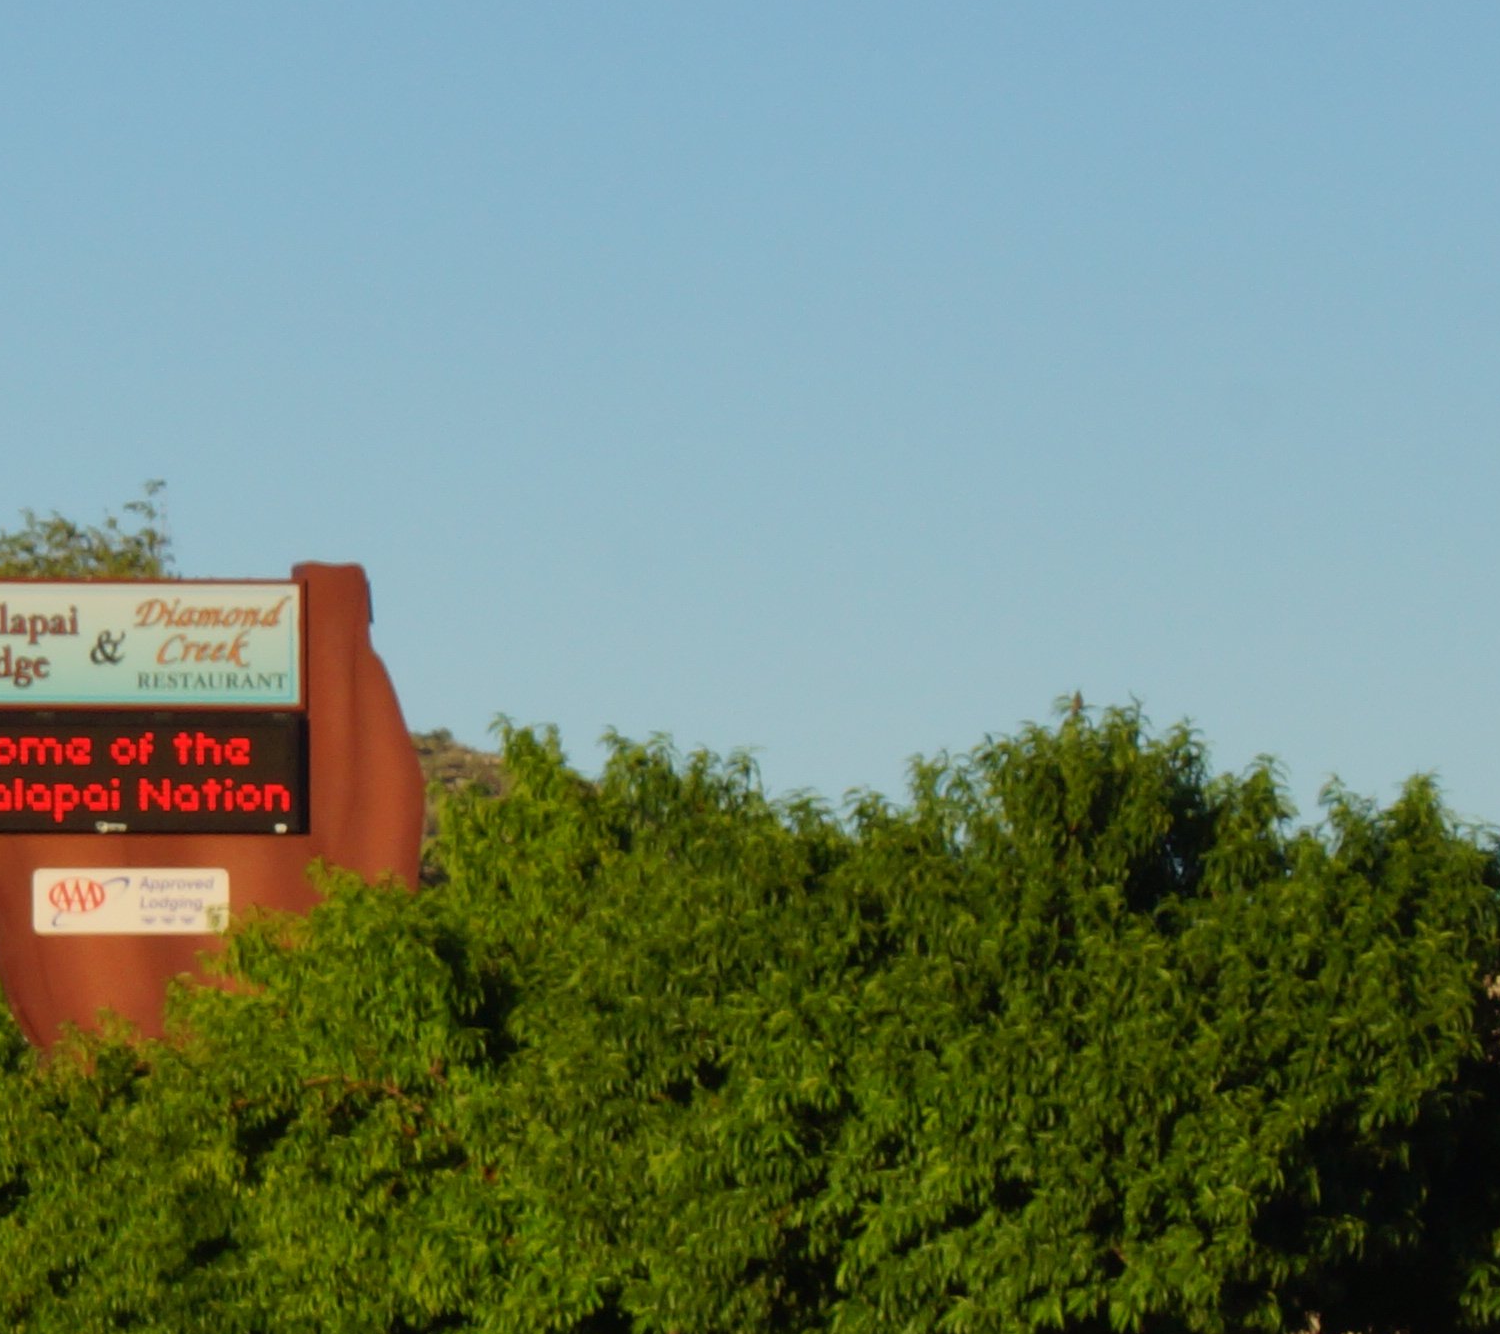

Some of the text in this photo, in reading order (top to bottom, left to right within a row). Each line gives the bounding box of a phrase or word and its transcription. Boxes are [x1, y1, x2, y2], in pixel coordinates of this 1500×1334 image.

[134, 595, 292, 628] Diamond
[90, 629, 125, 665] &
[157, 630, 252, 667] Creek
[137, 673, 287, 690] RESTAURANT
[110, 731, 154, 765] of
[173, 731, 250, 765] the
[137, 777, 291, 813] Nation
[48, 878, 105, 912] AAA
[140, 877, 214, 892] Approved
[140, 896, 203, 912] Lodging
